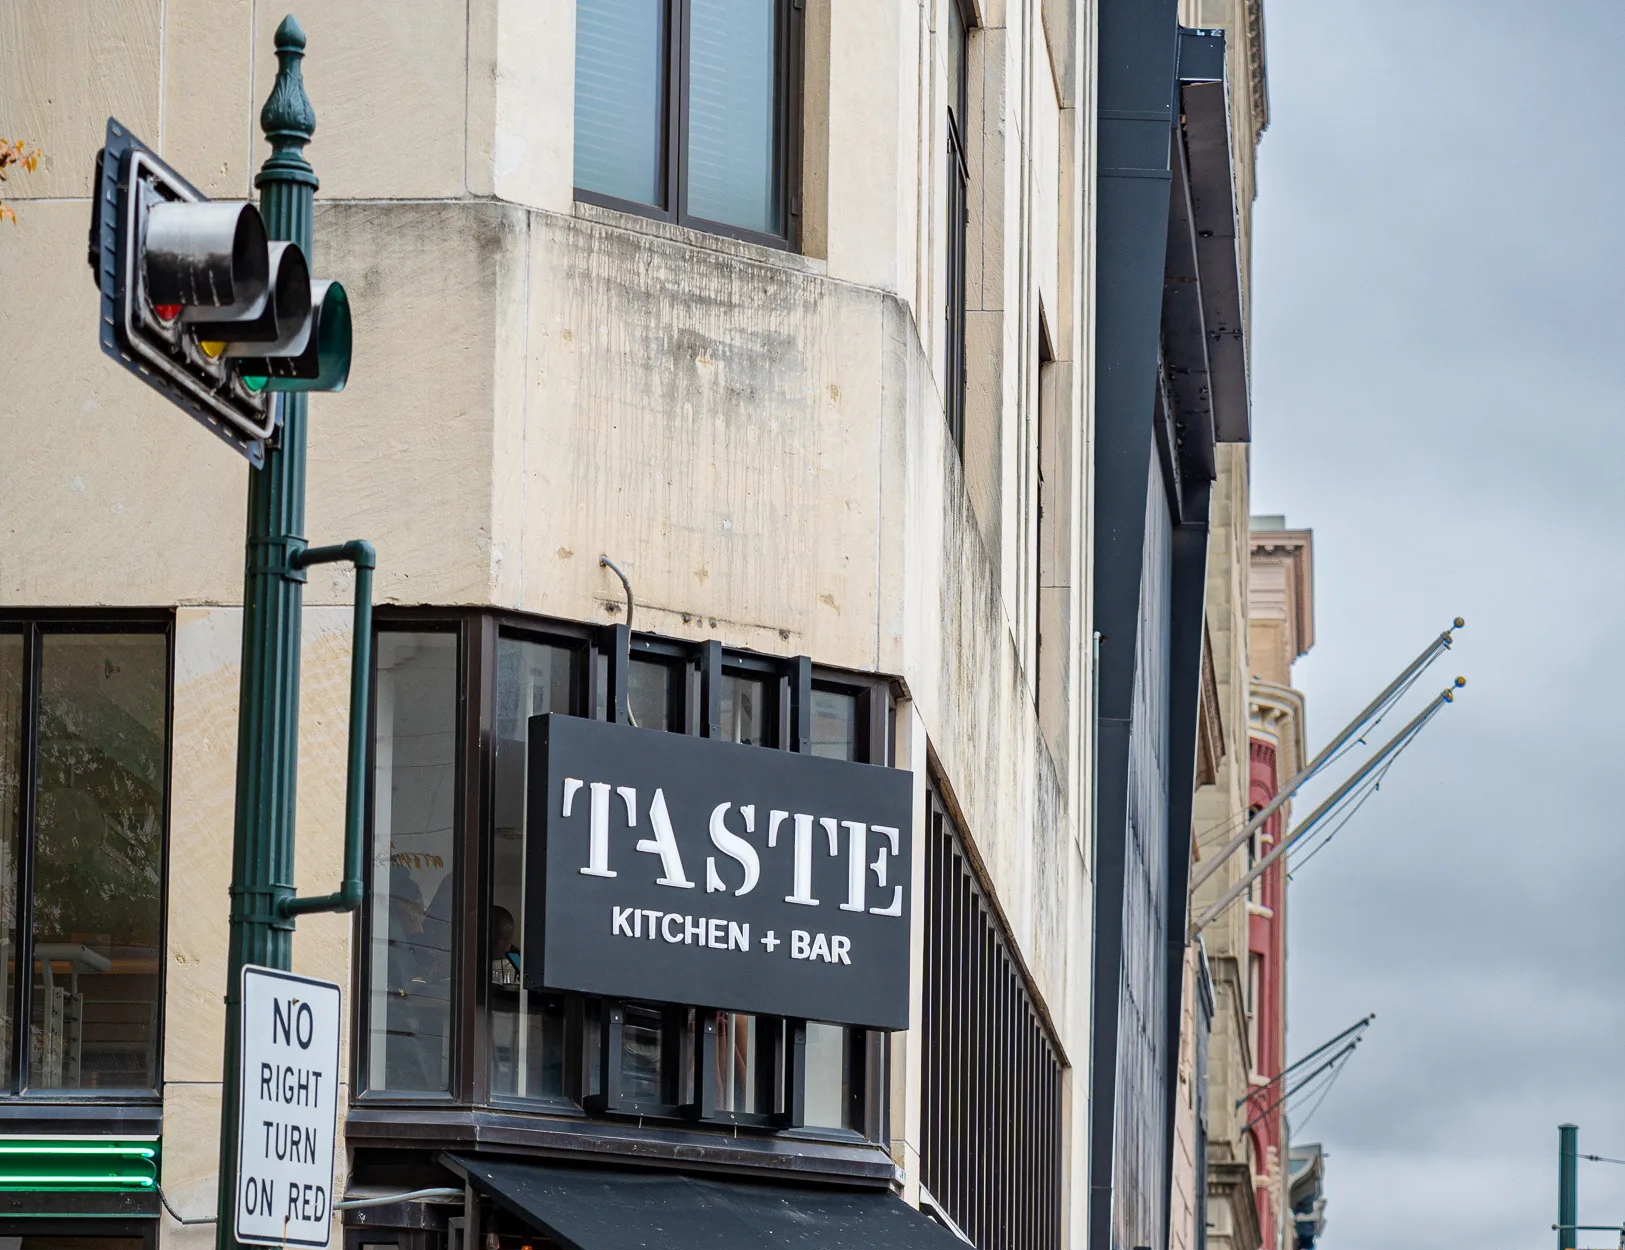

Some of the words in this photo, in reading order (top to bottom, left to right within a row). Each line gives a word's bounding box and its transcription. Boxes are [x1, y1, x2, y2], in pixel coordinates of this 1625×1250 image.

[562, 778, 902, 917] TASTE
[612, 906, 750, 952] KITCHEN
[791, 930, 851, 965] BAR
[273, 998, 313, 1050] NO
[260, 1063, 322, 1108] RIGHT
[263, 1121, 317, 1165] TURN
[245, 1177, 273, 1217] ON
[288, 1182, 325, 1223] RED
